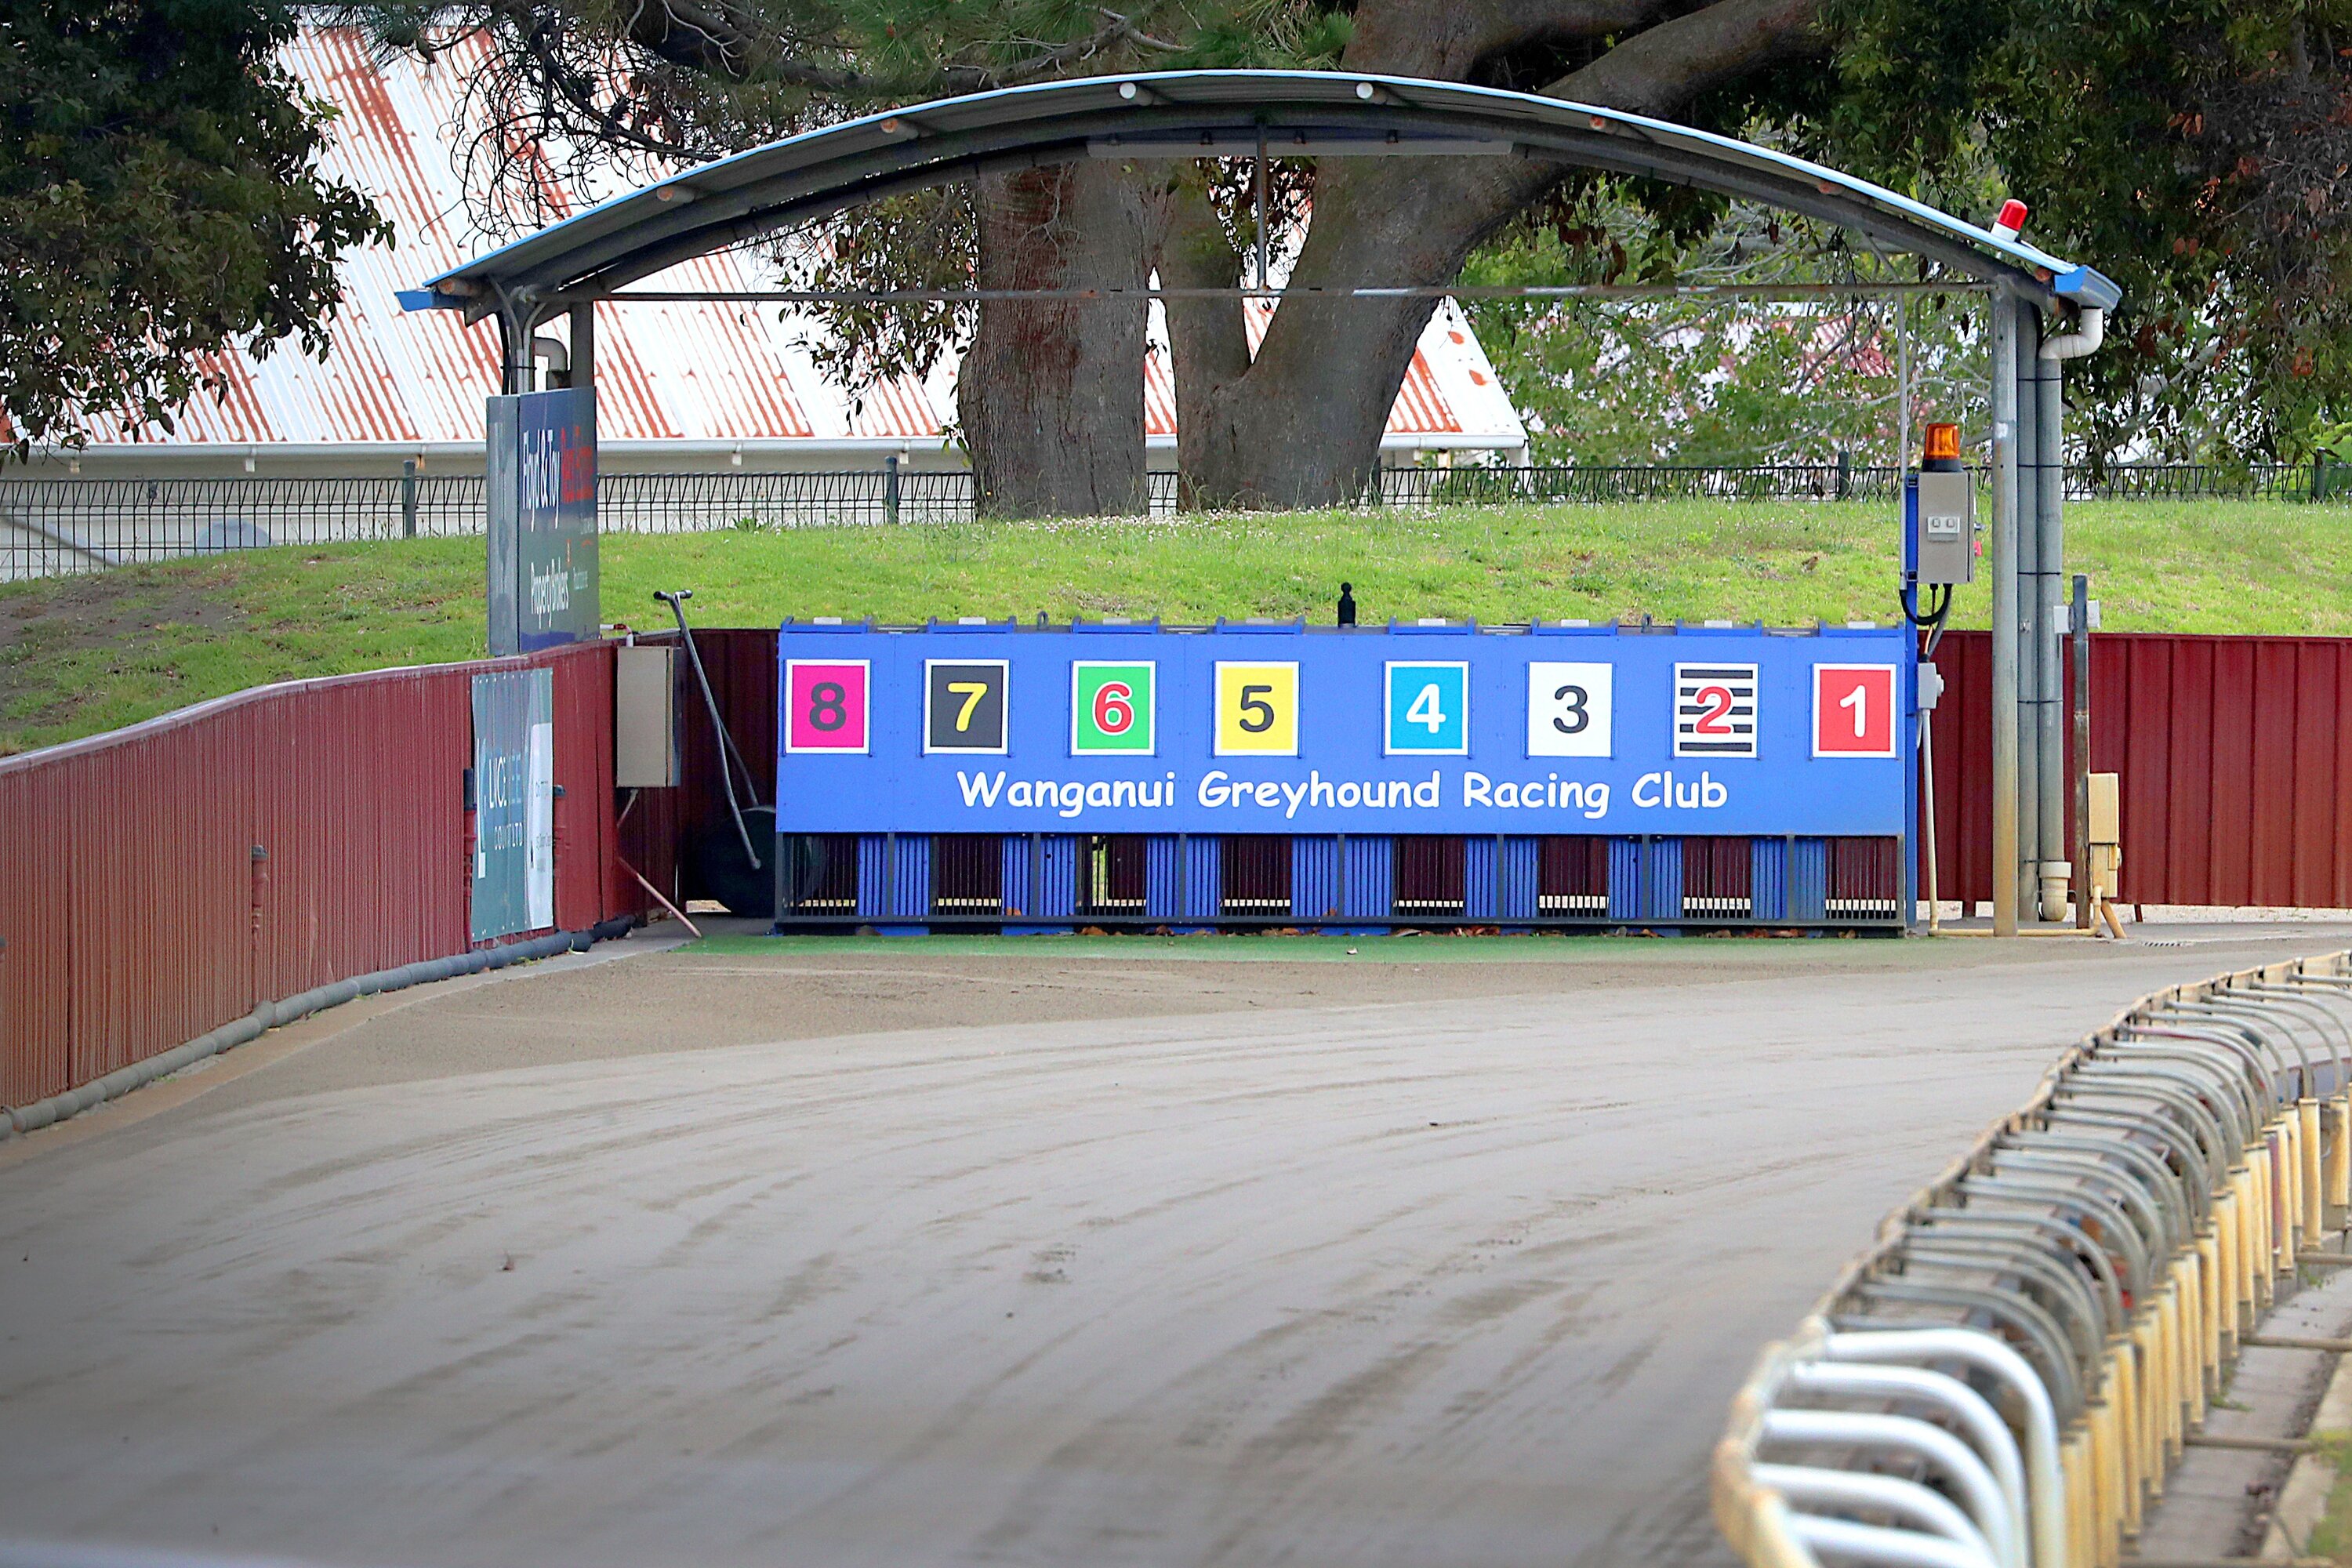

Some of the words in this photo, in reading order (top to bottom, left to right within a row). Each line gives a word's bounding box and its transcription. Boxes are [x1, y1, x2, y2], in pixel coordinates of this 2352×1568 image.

[540, 428, 548, 510] &
[808, 681, 848, 732] 8
[947, 681, 989, 733] 7
[1093, 681, 1134, 735] 6
[1238, 684, 1276, 734] 5
[1405, 682, 1448, 735] 4
[1552, 684, 1590, 735] 3
[1695, 685, 1733, 735] 2
[1838, 684, 1867, 739] 1
[956, 770, 1176, 819] Wanganui
[1197, 769, 1441, 820] Greyhound
[1463, 771, 1612, 820] Racing
[1631, 770, 1730, 809] Club
